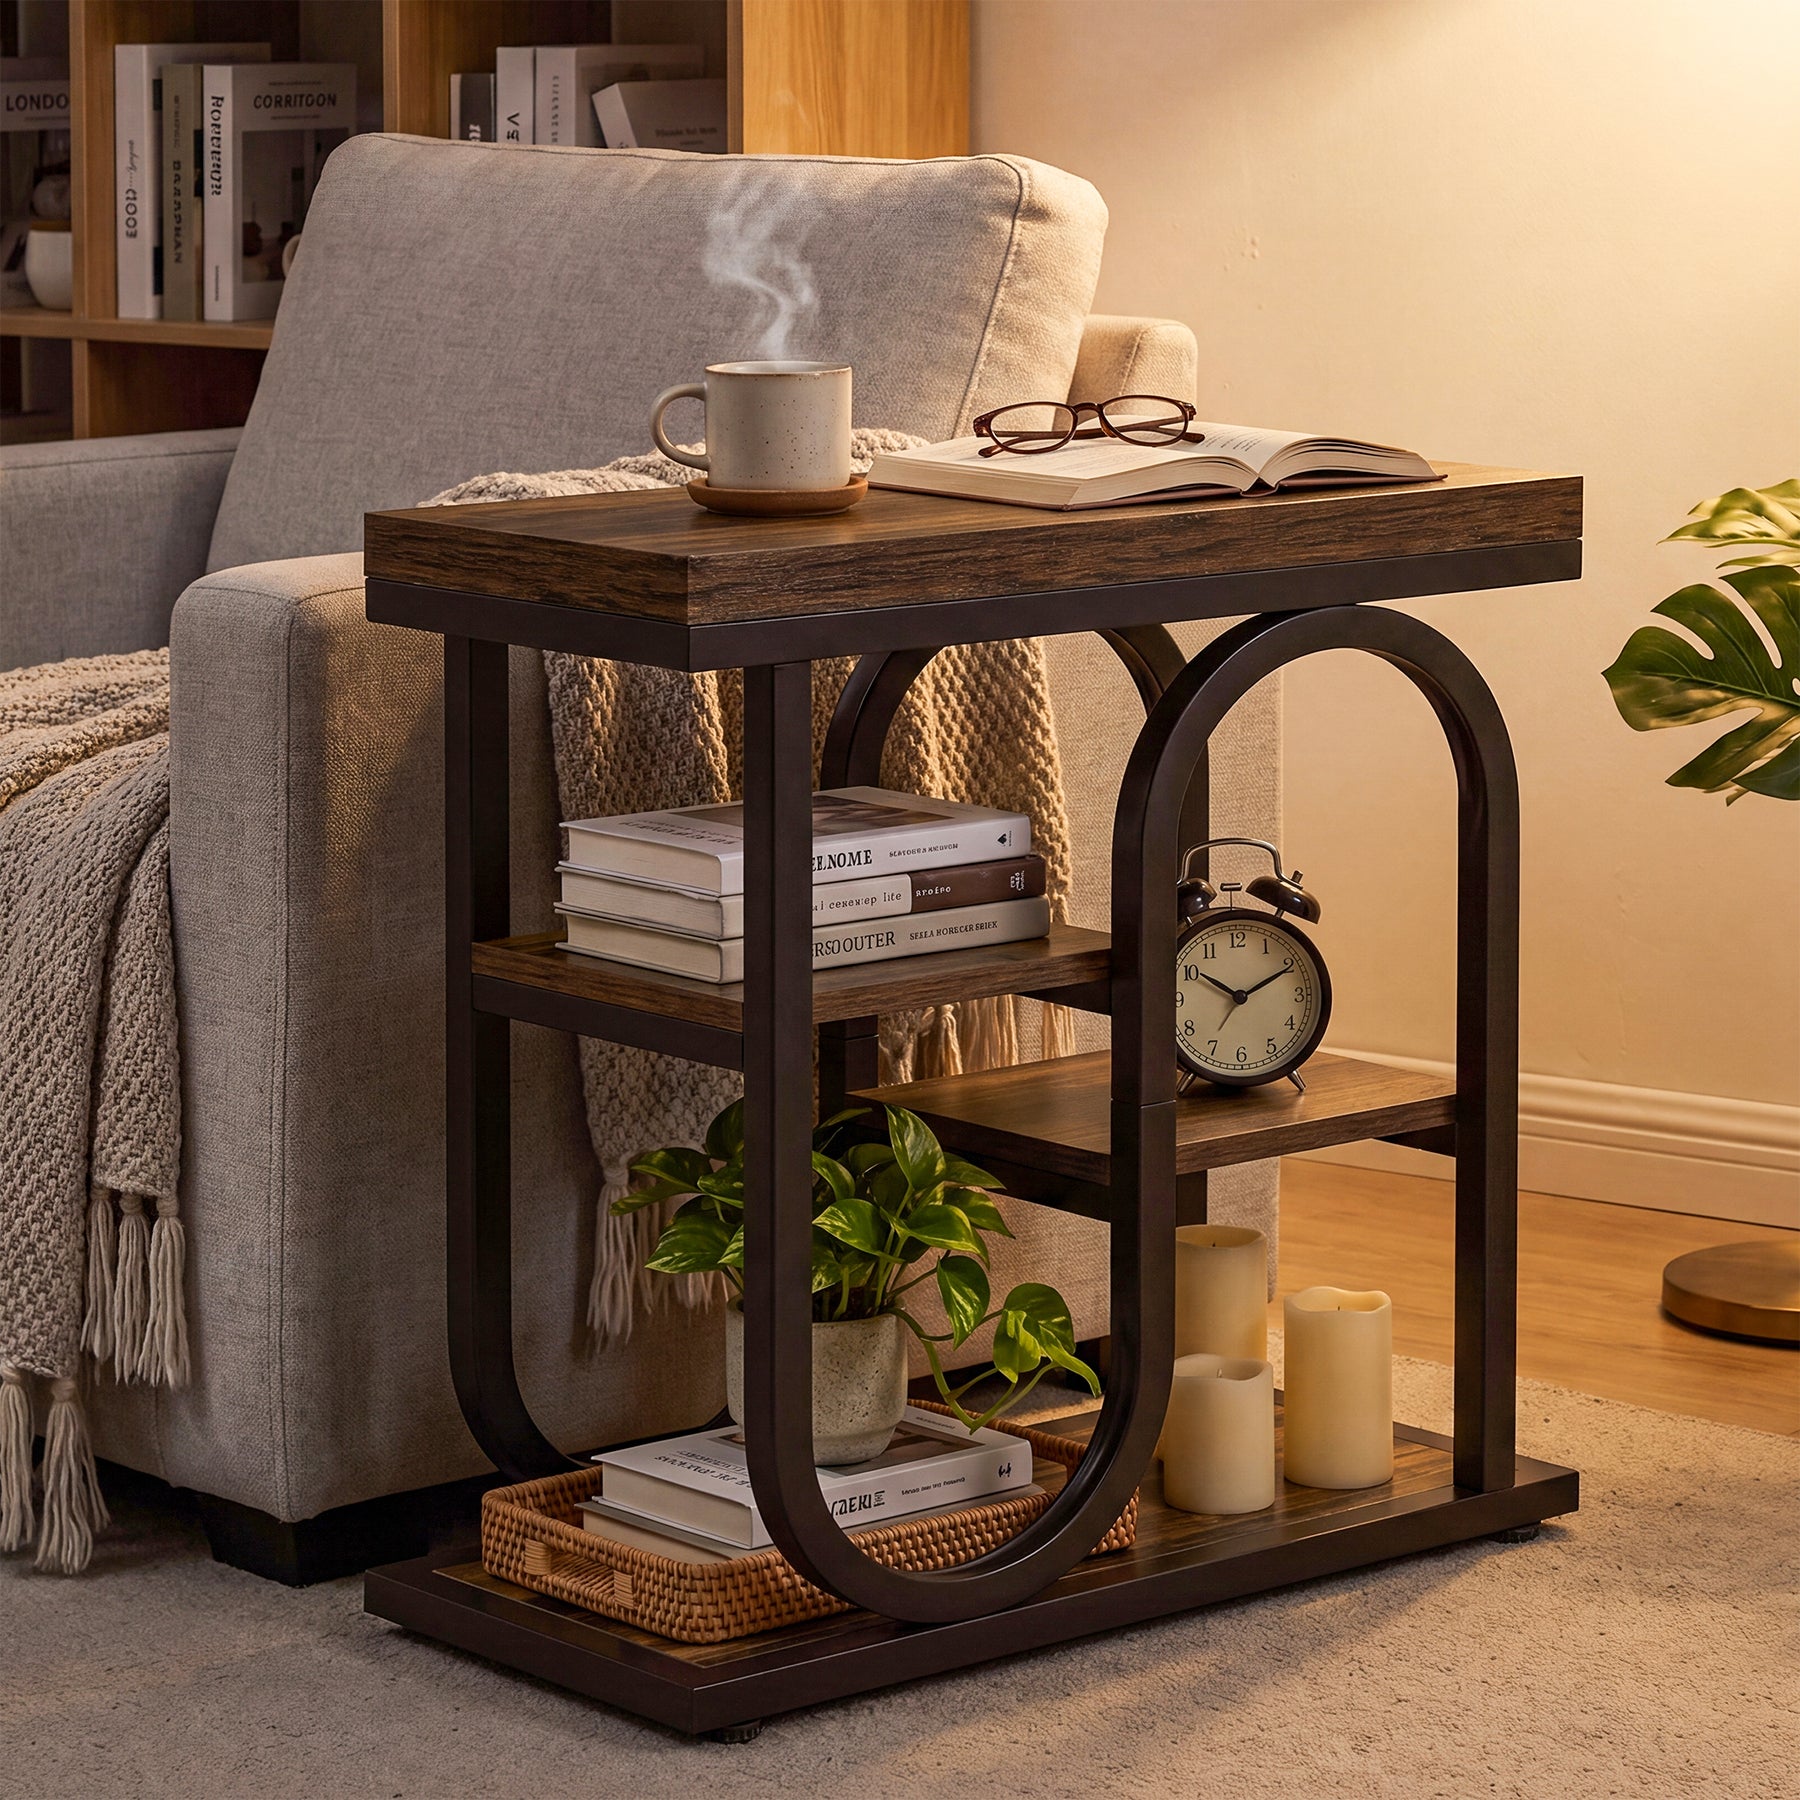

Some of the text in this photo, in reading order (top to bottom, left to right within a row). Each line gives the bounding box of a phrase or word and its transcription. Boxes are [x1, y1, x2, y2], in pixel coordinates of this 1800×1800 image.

[1229, 932, 1246, 948] 12
[1262, 938, 1270, 954] 1
[1203, 943, 1217, 959] 11
[1183, 965, 1199, 981] 10
[1283, 957, 1295, 974] 2
[1176, 991, 1184, 1008] 9
[1294, 987, 1305, 1003] 3
[1184, 1020, 1195, 1036] 8
[1284, 1015, 1296, 1030] 4
[1207, 1040, 1218, 1056] 7
[1266, 1037, 1277, 1054] 5
[1236, 1047, 1247, 1062] 6
